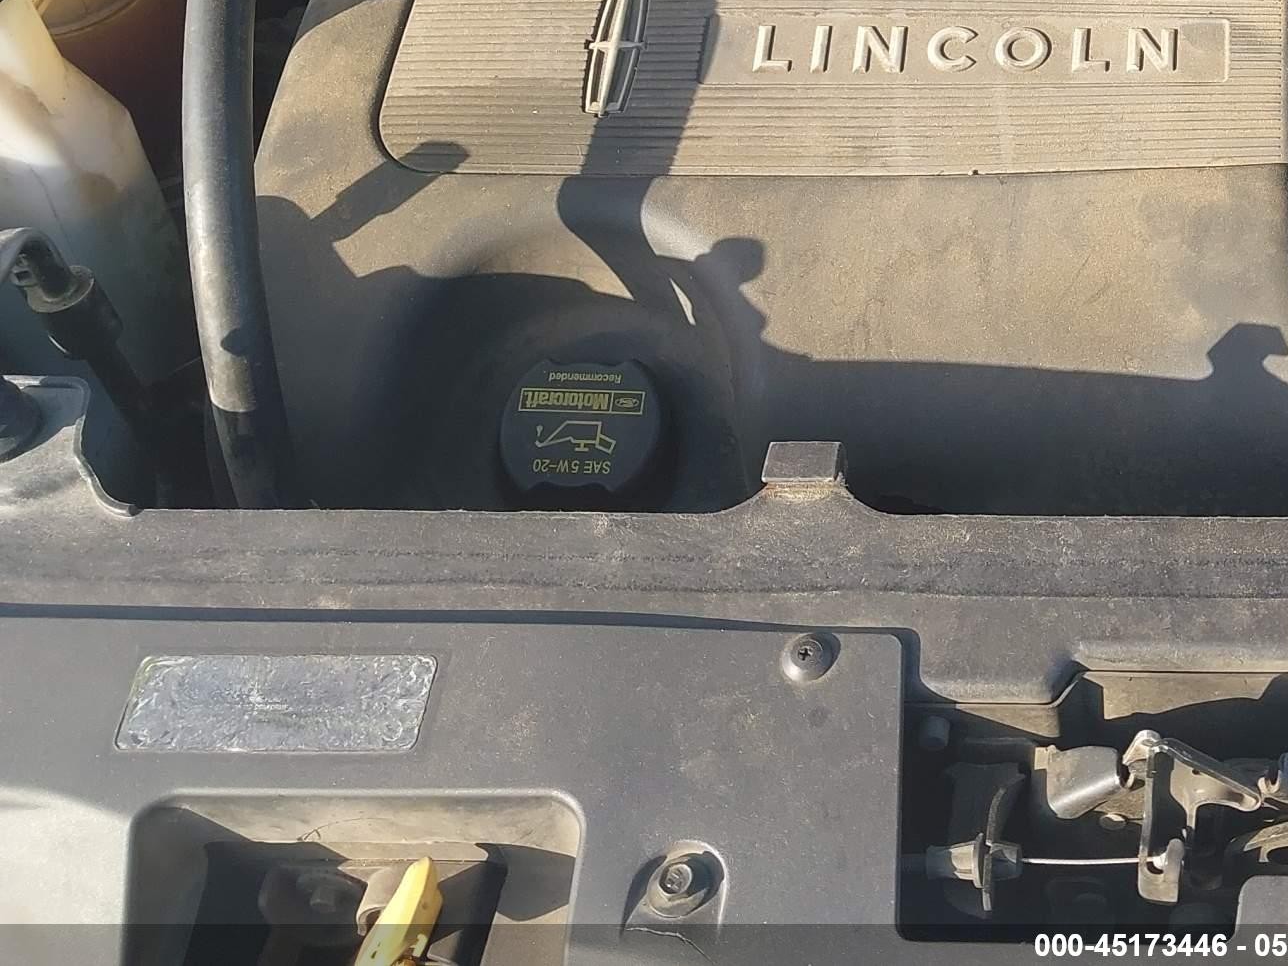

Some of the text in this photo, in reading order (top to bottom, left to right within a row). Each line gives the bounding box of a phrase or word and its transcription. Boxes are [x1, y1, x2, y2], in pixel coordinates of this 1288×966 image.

[752, 24, 1180, 74] LINCOLN
[548, 372, 622, 384] Recommended
[526, 391, 609, 410] Motorcraft
[584, 460, 611, 474] SAE
